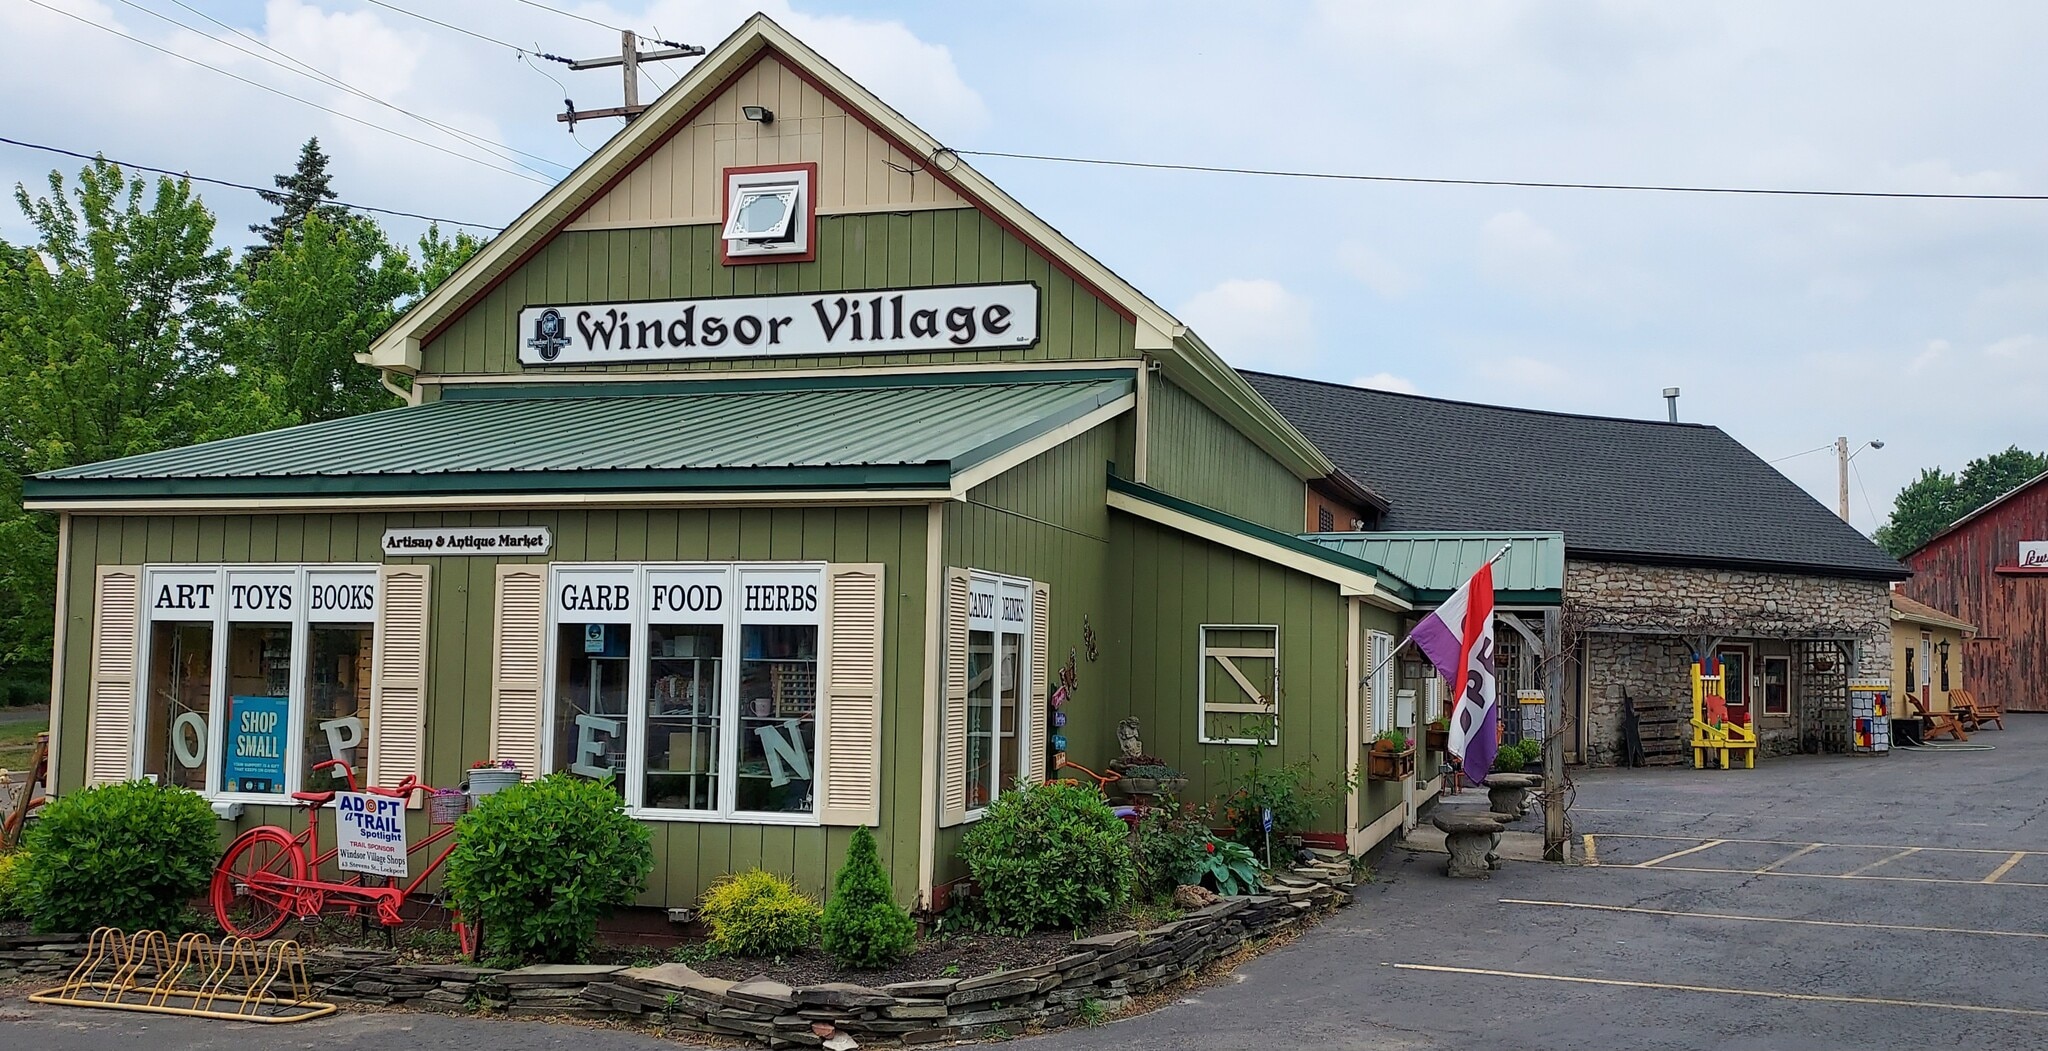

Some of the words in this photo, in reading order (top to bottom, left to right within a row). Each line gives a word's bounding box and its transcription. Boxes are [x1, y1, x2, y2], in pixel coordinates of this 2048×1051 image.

[577, 304, 792, 351] Windsor
[810, 295, 1013, 345] Village
[386, 536, 433, 550] Artisan
[435, 535, 445, 547] &
[447, 535, 496, 550] Antique
[498, 534, 543, 548] Market
[154, 584, 214, 610] ART
[231, 584, 293, 610] TOYS
[311, 584, 375, 611] BOOKS
[561, 583, 630, 612] GARB
[651, 584, 723, 612] FOOD
[744, 584, 818, 612] HERBS
[968, 591, 994, 619] CANDY
[241, 710, 278, 733] SHOP
[236, 735, 279, 758] SMALL
[340, 795, 400, 817] ADOPT
[344, 812, 354, 821] a
[353, 813, 402, 833] TRAIL
[349, 841, 366, 849] TRAIL
[367, 843, 395, 852] SPONSOR
[360, 828, 402, 842] Spotlight
[339, 849, 366, 860] Windsor
[366, 851, 386, 865] Village
[386, 854, 406, 867] Shops
[380, 866, 405, 875] Lockport
